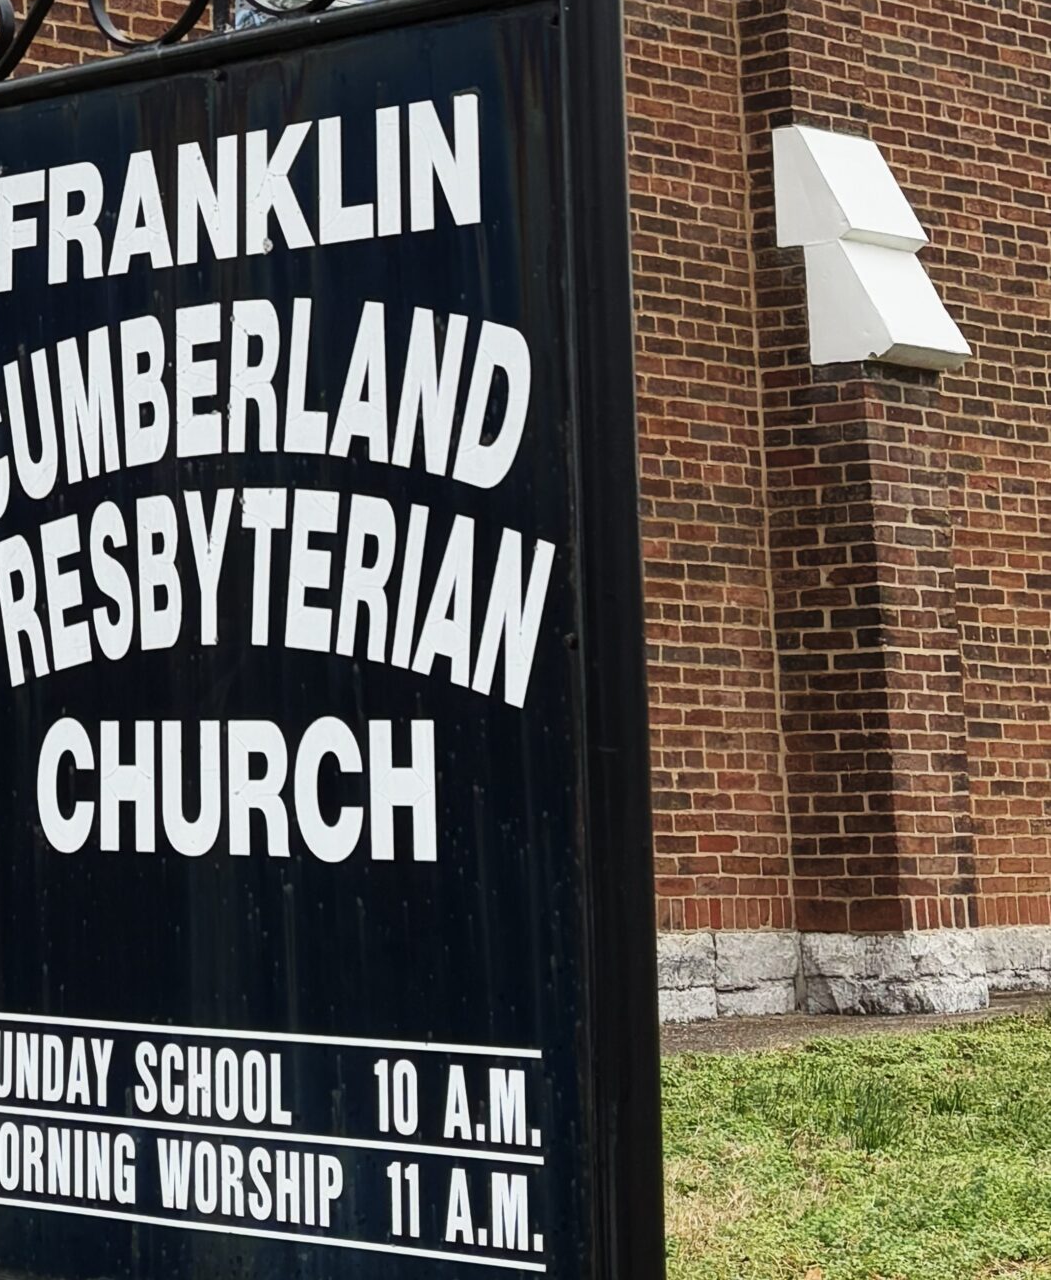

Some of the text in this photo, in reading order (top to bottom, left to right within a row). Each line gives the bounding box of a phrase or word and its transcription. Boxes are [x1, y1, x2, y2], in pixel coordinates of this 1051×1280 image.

[36, 716, 437, 862] CHURCH
[134, 1041, 292, 1126] SCHOOL
[373, 1058, 419, 1136] 10
[443, 1064, 542, 1148] A.M.
[156, 1137, 344, 1228] WORSHIP
[386, 1161, 420, 1238] 11
[444, 1167, 544, 1253] A.M.
